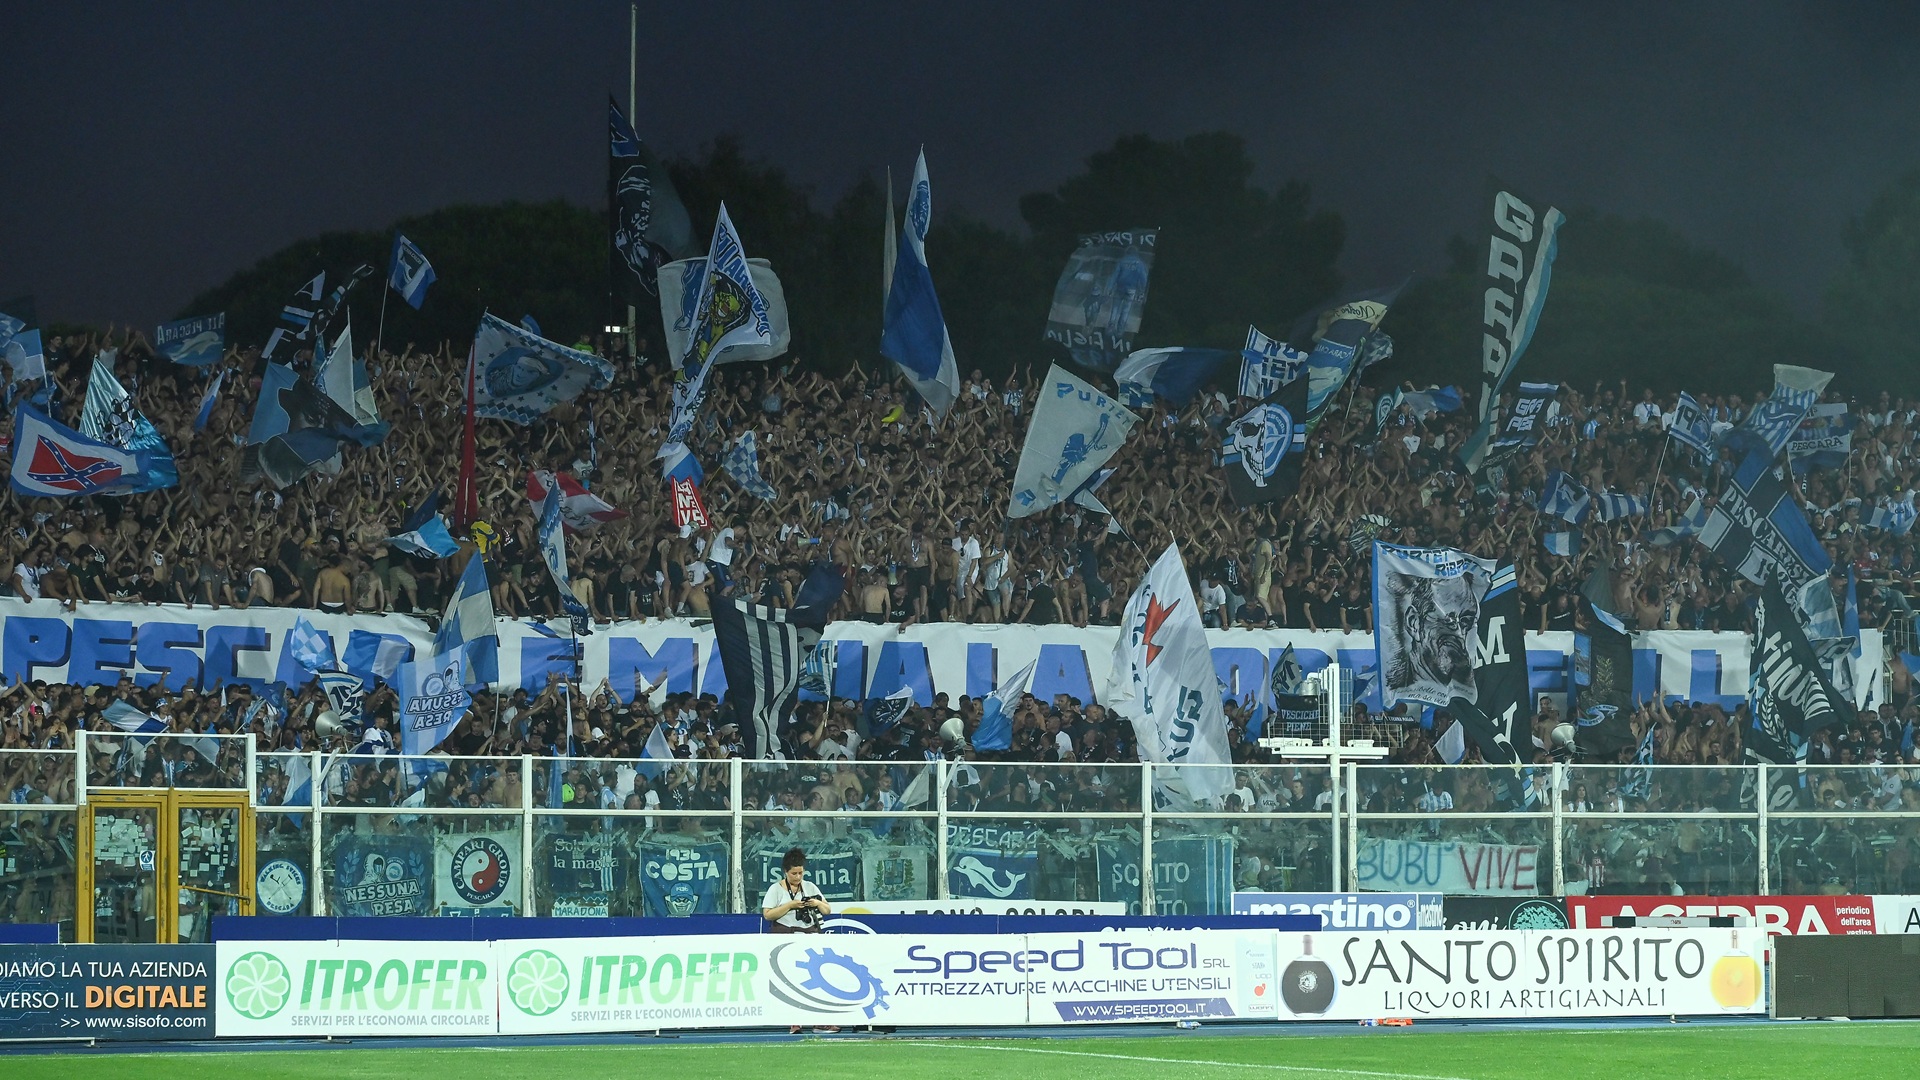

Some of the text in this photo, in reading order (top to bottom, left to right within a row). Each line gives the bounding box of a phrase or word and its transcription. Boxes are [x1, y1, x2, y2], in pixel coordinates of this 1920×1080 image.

[1791, 436, 1843, 451] PESCARA
[453, 840, 509, 890] CAMPARI GROUP
[553, 855, 566, 868] la
[645, 860, 721, 881] COSTA
[1459, 844, 1538, 891] VIVE
[260, 863, 285, 884] WALKING
[1111, 861, 1190, 885] SOITO
[345, 881, 420, 903] NESSUNA
[466, 891, 495, 901] PESCARA
[372, 898, 415, 916] RESA
[554, 907, 608, 916] MARADONA
[1836, 905, 1870, 917] periodico
[1840, 917, 1872, 926] dell'area
[893, 939, 1231, 980] Speed Tool SRL
[1341, 936, 1517, 987] SANTO
[1536, 935, 1705, 986] SPIRITO
[0, 961, 208, 978] IAMO LA TUA AZIENDA
[300, 958, 488, 1011] ITROFER
[578, 952, 759, 1007] ITROFER
[894, 977, 1232, 996] ATTREZZATURE MACCHINE UTENSILI
[0, 985, 207, 1009] VERSO IL DIGITALE
[1384, 986, 1667, 1014] LIQUORI ARTIGIANALI
[570, 1006, 763, 1023] SERVIZI PER L'ECONOMIA CIRCOLARE
[1073, 1001, 1208, 1017] WWW.SPEEDTOOL.IT
[85, 1013, 208, 1029] www.sisofo.com
[291, 1014, 490, 1027] SERVIZI PER L'ECONOMIA CIRCOLARE
